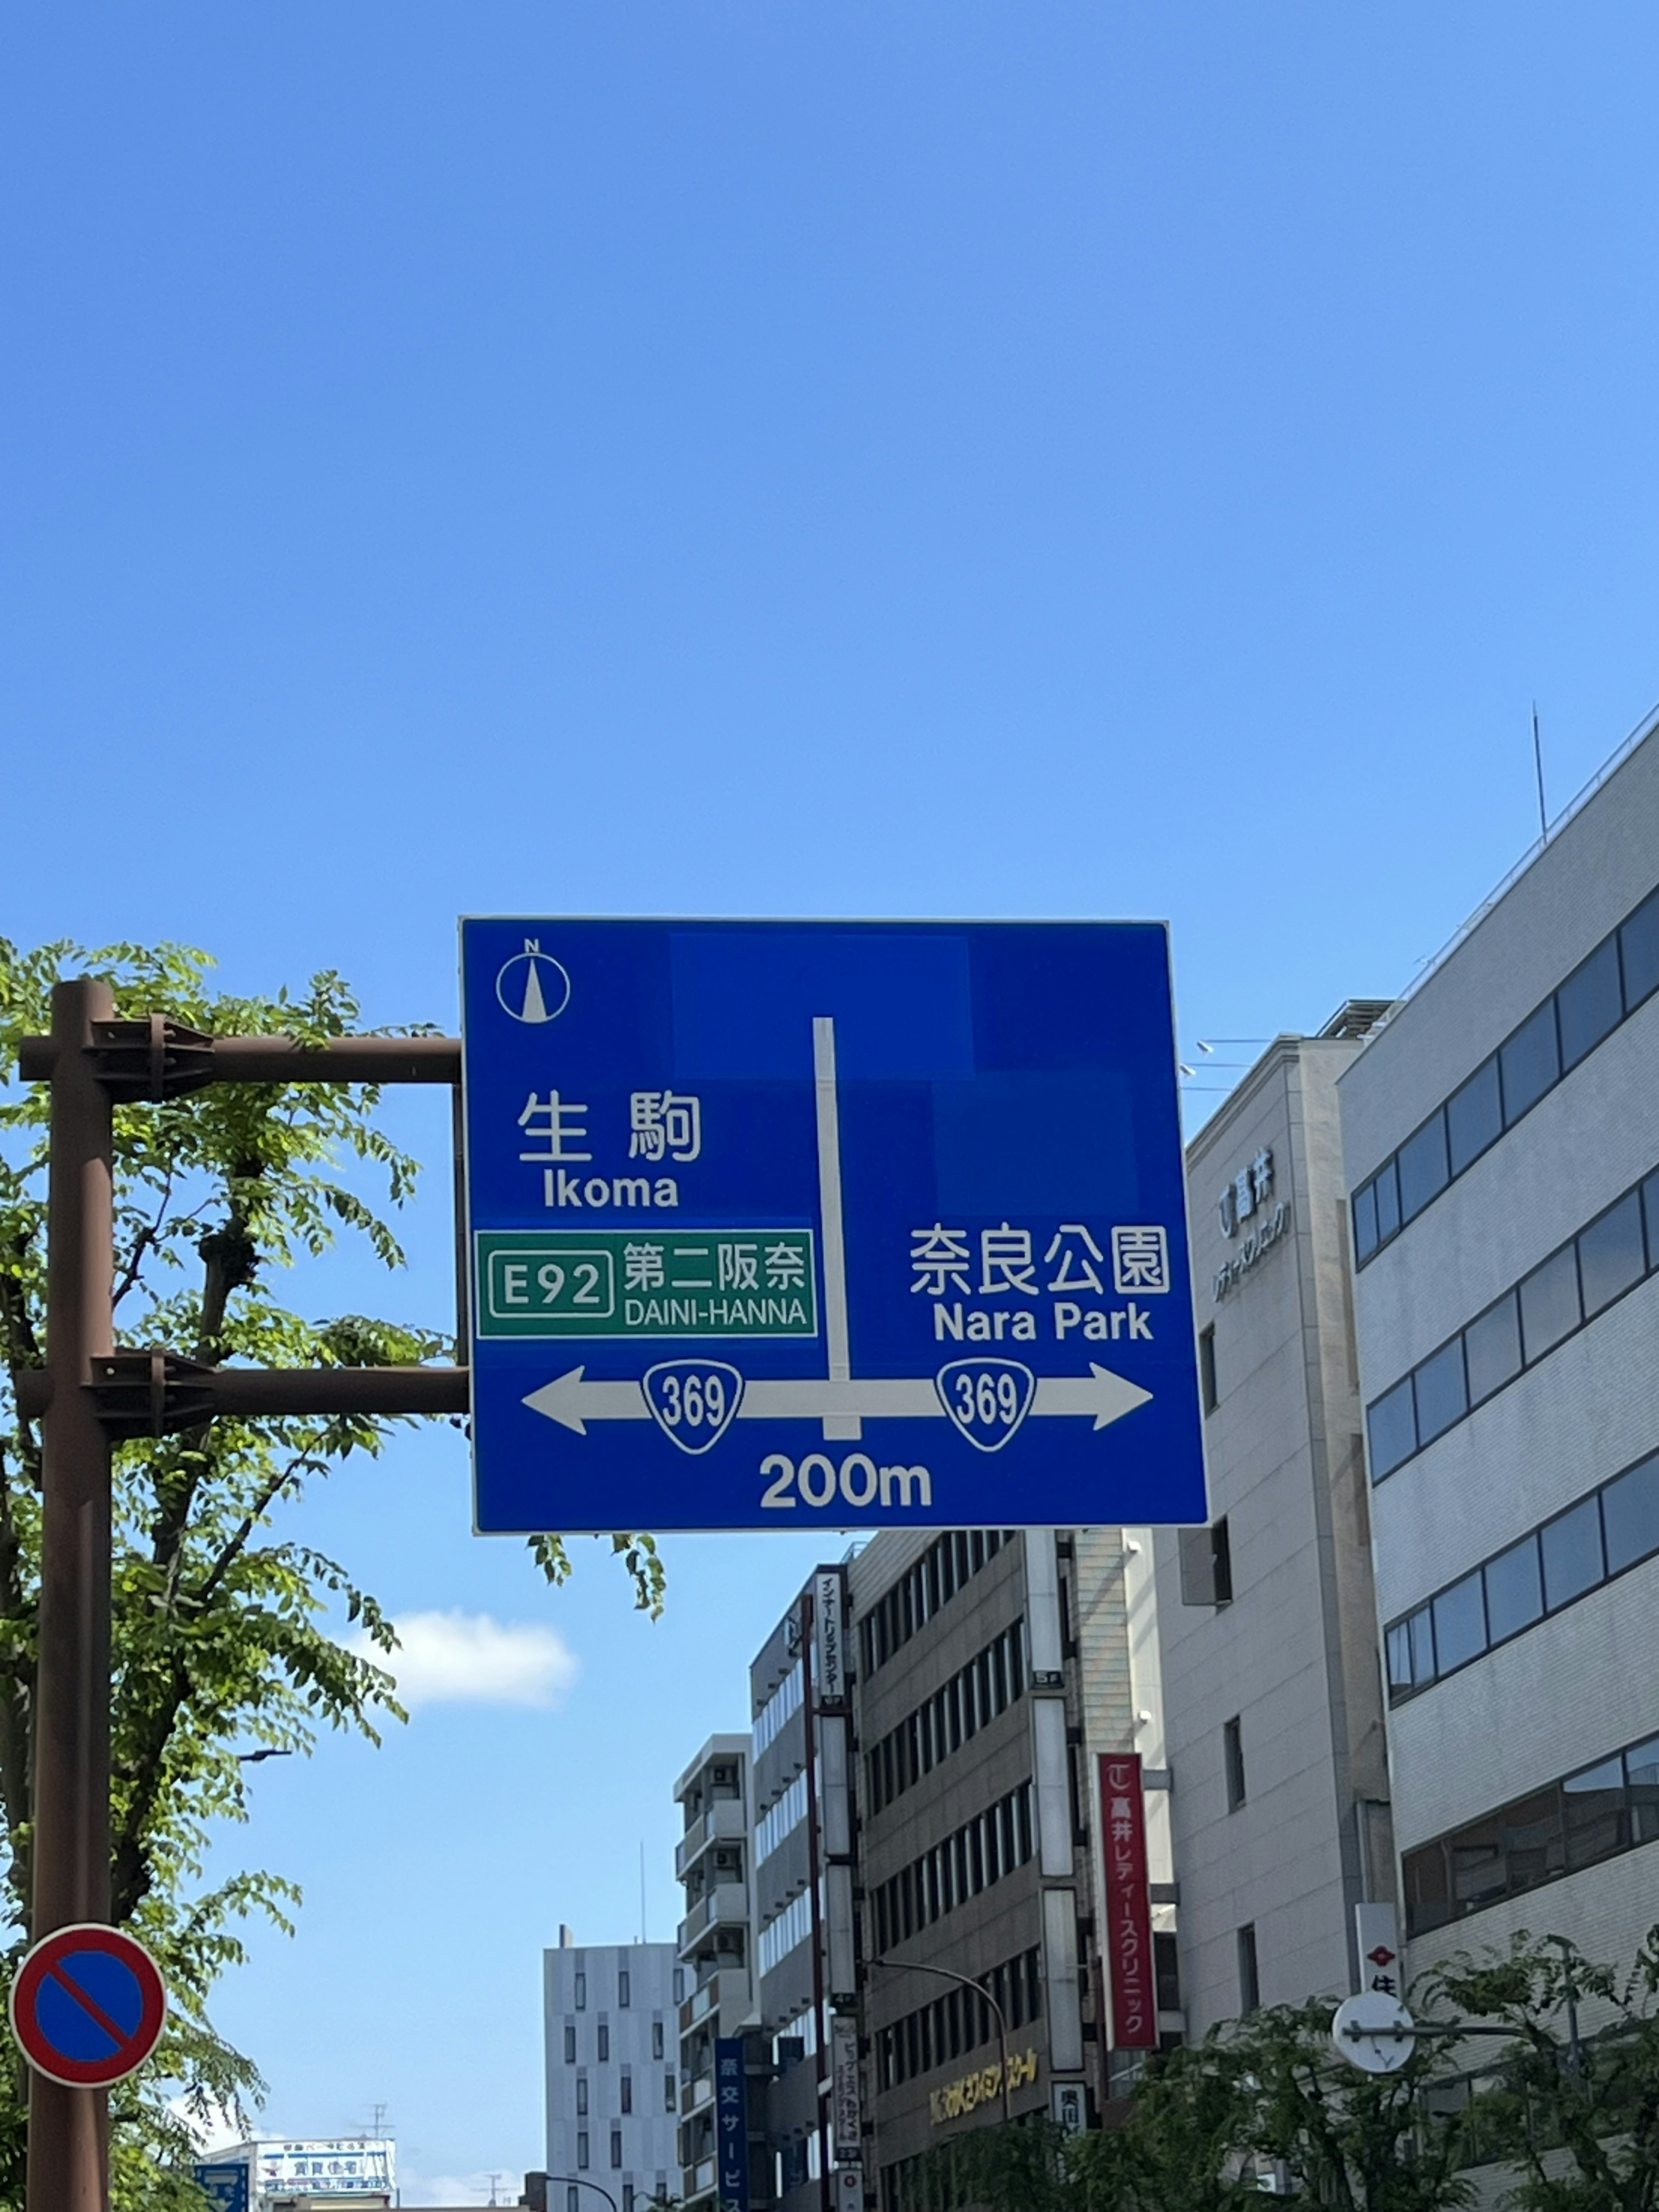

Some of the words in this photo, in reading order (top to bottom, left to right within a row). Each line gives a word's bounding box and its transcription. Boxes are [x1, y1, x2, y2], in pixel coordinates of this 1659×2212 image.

[524, 938, 539, 952] N
[518, 1090, 700, 1162] 生駒
[544, 1169, 678, 1208] Ikoma
[623, 1242, 805, 1291] 第二阪奈
[910, 1222, 1170, 1295] 奈良公園
[504, 1264, 600, 1304] E92
[625, 1298, 807, 1325] DAINI-HANNA
[934, 1302, 1036, 1341] Nara
[1054, 1302, 1154, 1340] Park
[662, 1375, 725, 1427] 369
[955, 1373, 1017, 1424] 369
[760, 1453, 932, 1508] 200m
